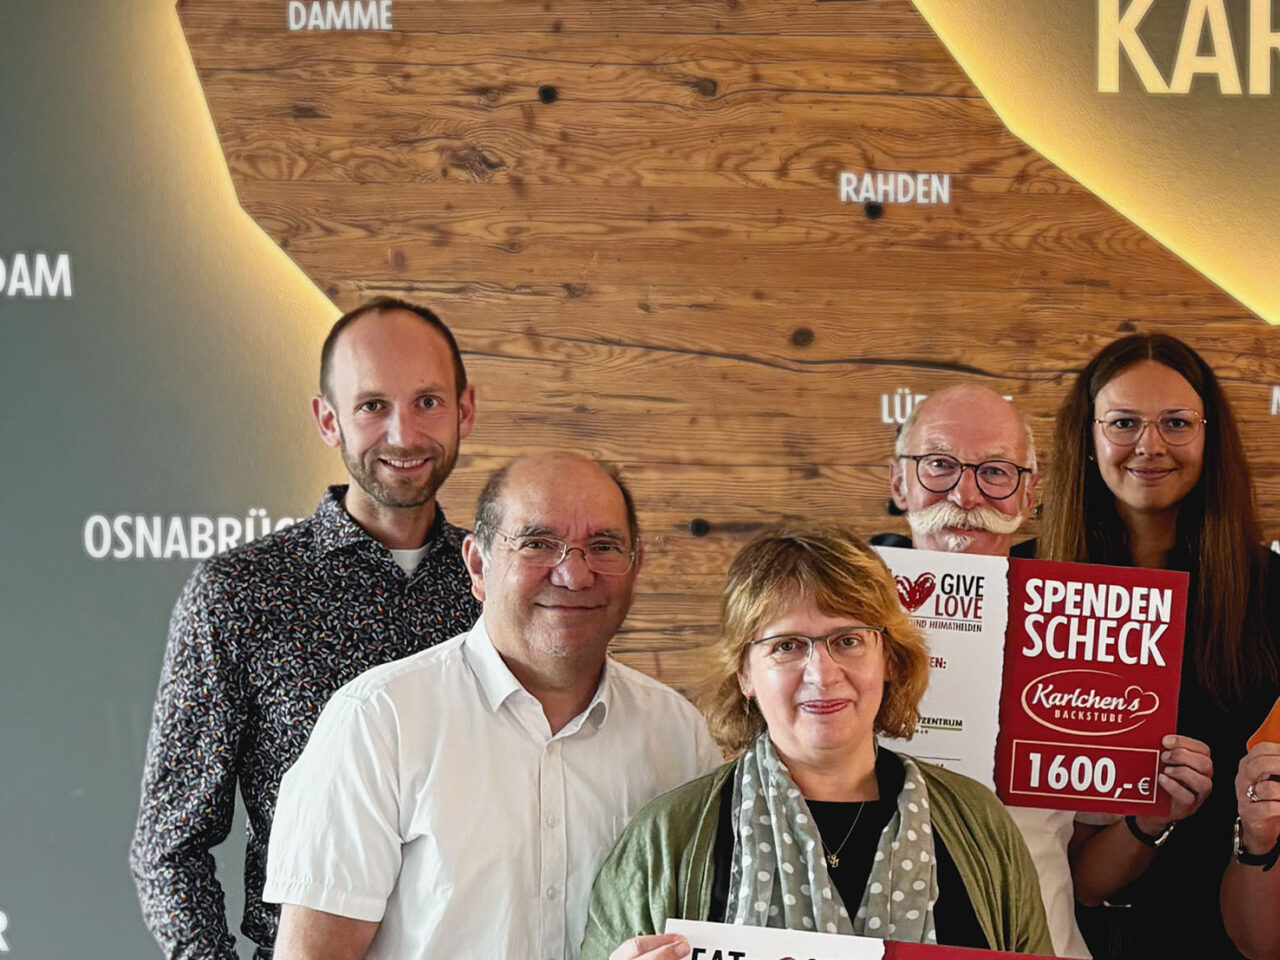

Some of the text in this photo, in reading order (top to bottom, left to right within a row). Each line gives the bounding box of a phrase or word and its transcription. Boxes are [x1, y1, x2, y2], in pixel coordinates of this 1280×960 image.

[288, 0, 393, 31] DAMME
[839, 172, 950, 204] RAHDEN
[84, 508, 306, 559] OSNABRÜ
[941, 573, 985, 598] GIVE
[1023, 577, 1173, 623] SPENDEN
[934, 594, 984, 620] LOVE
[929, 620, 982, 632] HEIMATHELDEN
[1021, 613, 1169, 667] SCHECK
[1054, 709, 1123, 723] BACKSTUBE
